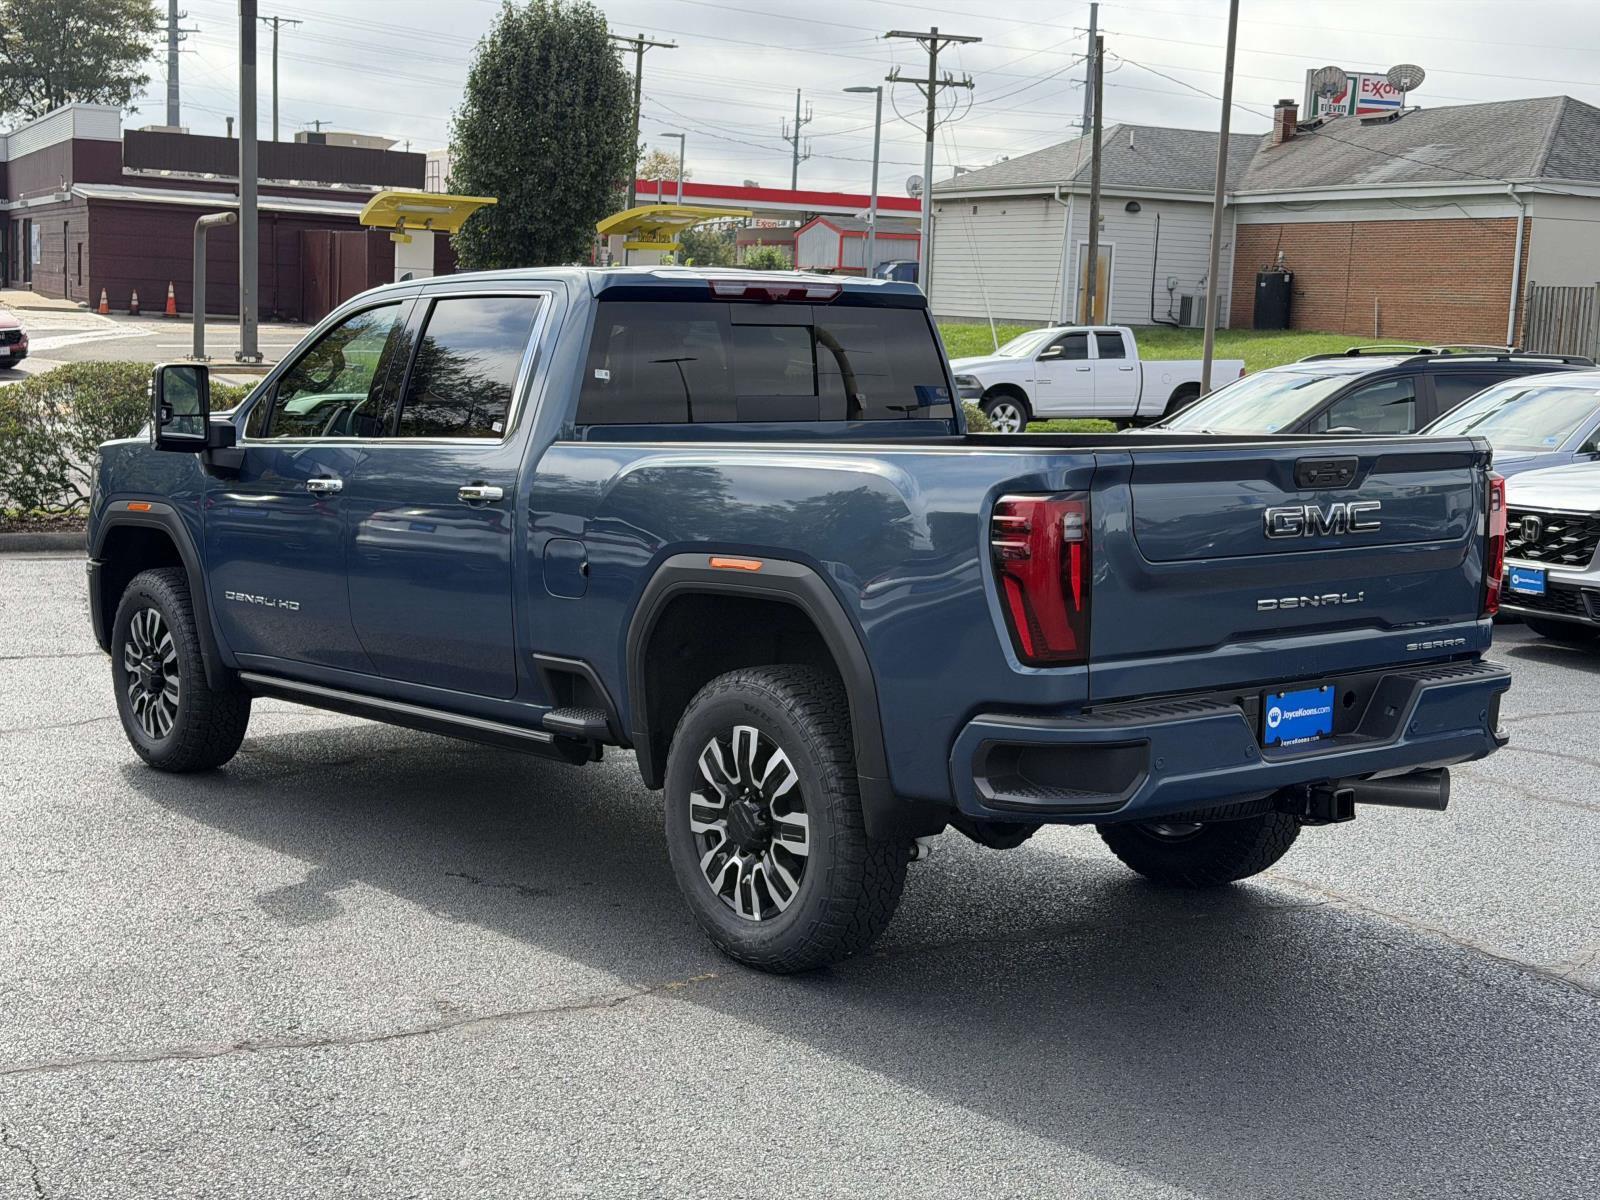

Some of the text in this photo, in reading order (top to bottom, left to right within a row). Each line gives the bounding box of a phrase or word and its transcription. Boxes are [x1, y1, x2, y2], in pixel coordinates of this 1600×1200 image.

[1264, 500, 1382, 539] GMC
[225, 590, 300, 611] DENALI HD
[1256, 591, 1365, 611] DENALI
[1406, 638, 1466, 651] SIERRA
